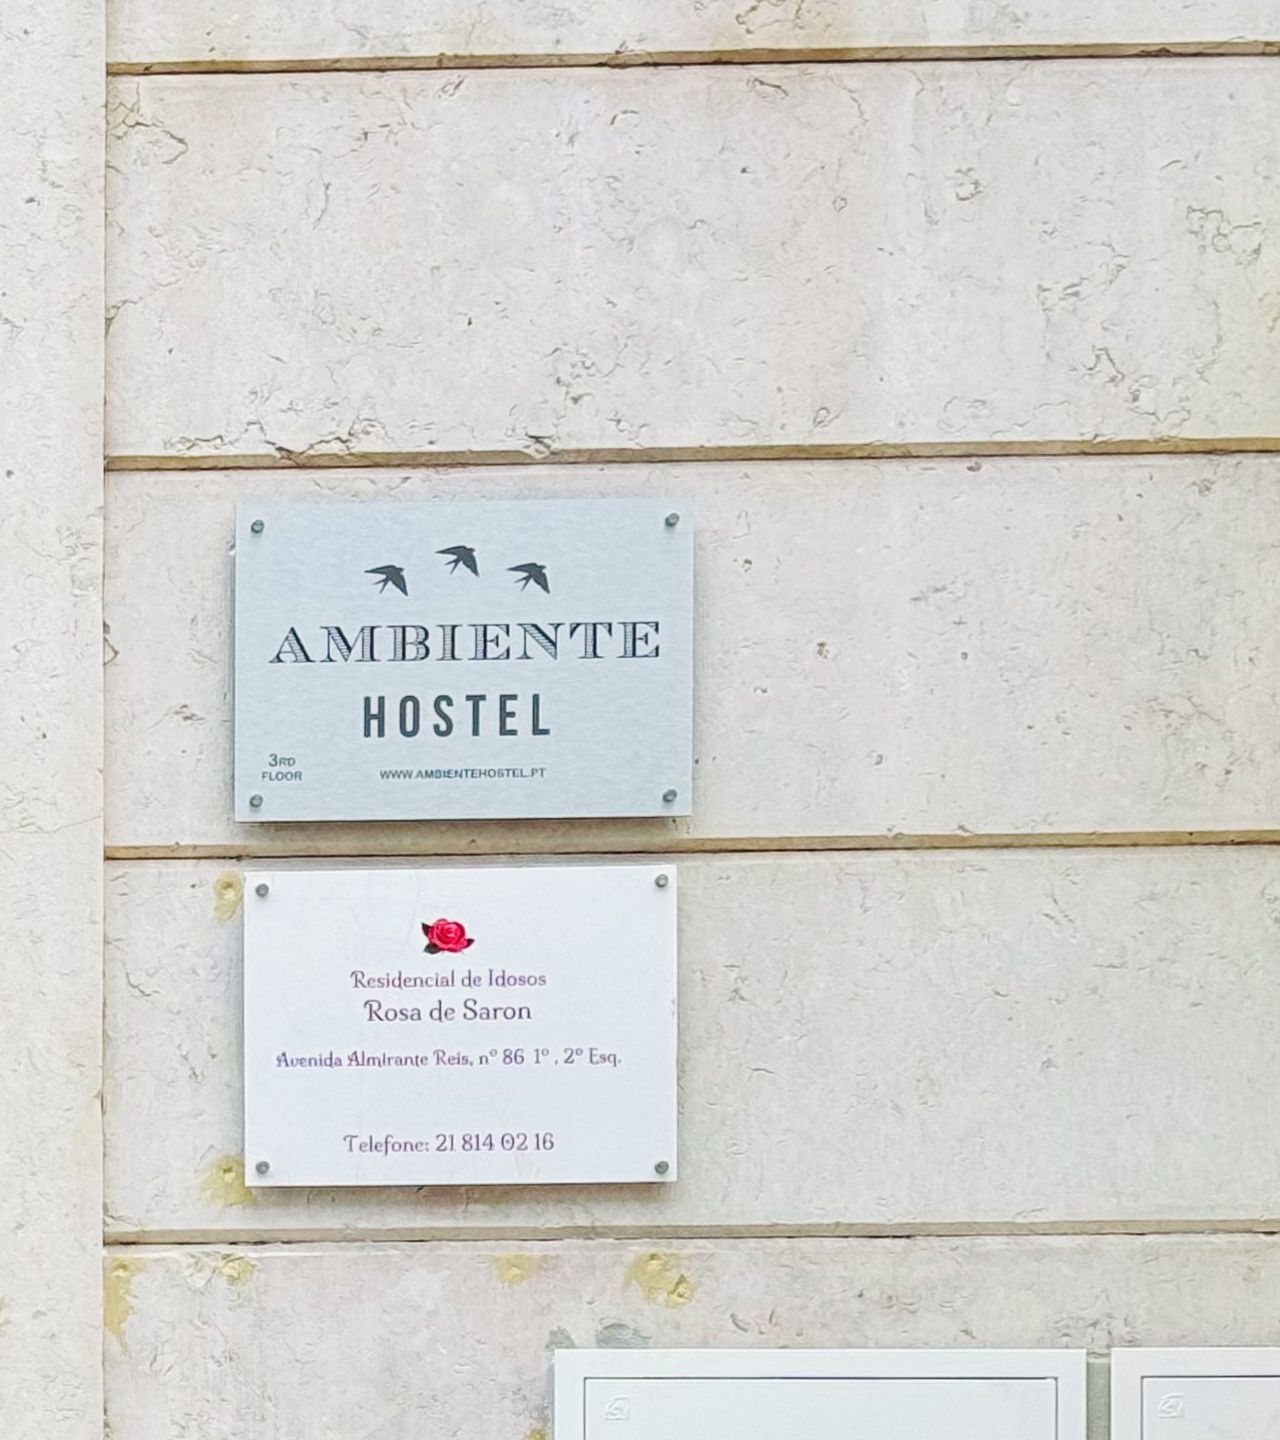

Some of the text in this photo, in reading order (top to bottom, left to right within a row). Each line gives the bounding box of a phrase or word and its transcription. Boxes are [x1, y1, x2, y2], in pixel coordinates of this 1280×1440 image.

[268, 621, 659, 664] AMBIENTE
[364, 693, 550, 738] HOSTEL
[269, 753, 295, 767] 3RD
[262, 771, 302, 781] FLOOR
[380, 768, 546, 779] WWW.AMBIENTEHOSTEL.PT
[350, 969, 546, 990] Residencial de Idosos
[363, 998, 532, 1023] Rosa de Saron
[277, 1051, 342, 1068] Avenida
[347, 1051, 428, 1068] Almirante
[503, 1049, 524, 1065] 86
[589, 1048, 621, 1067] Esq.
[343, 1133, 554, 1156] Telefone: 21 814 02 16
